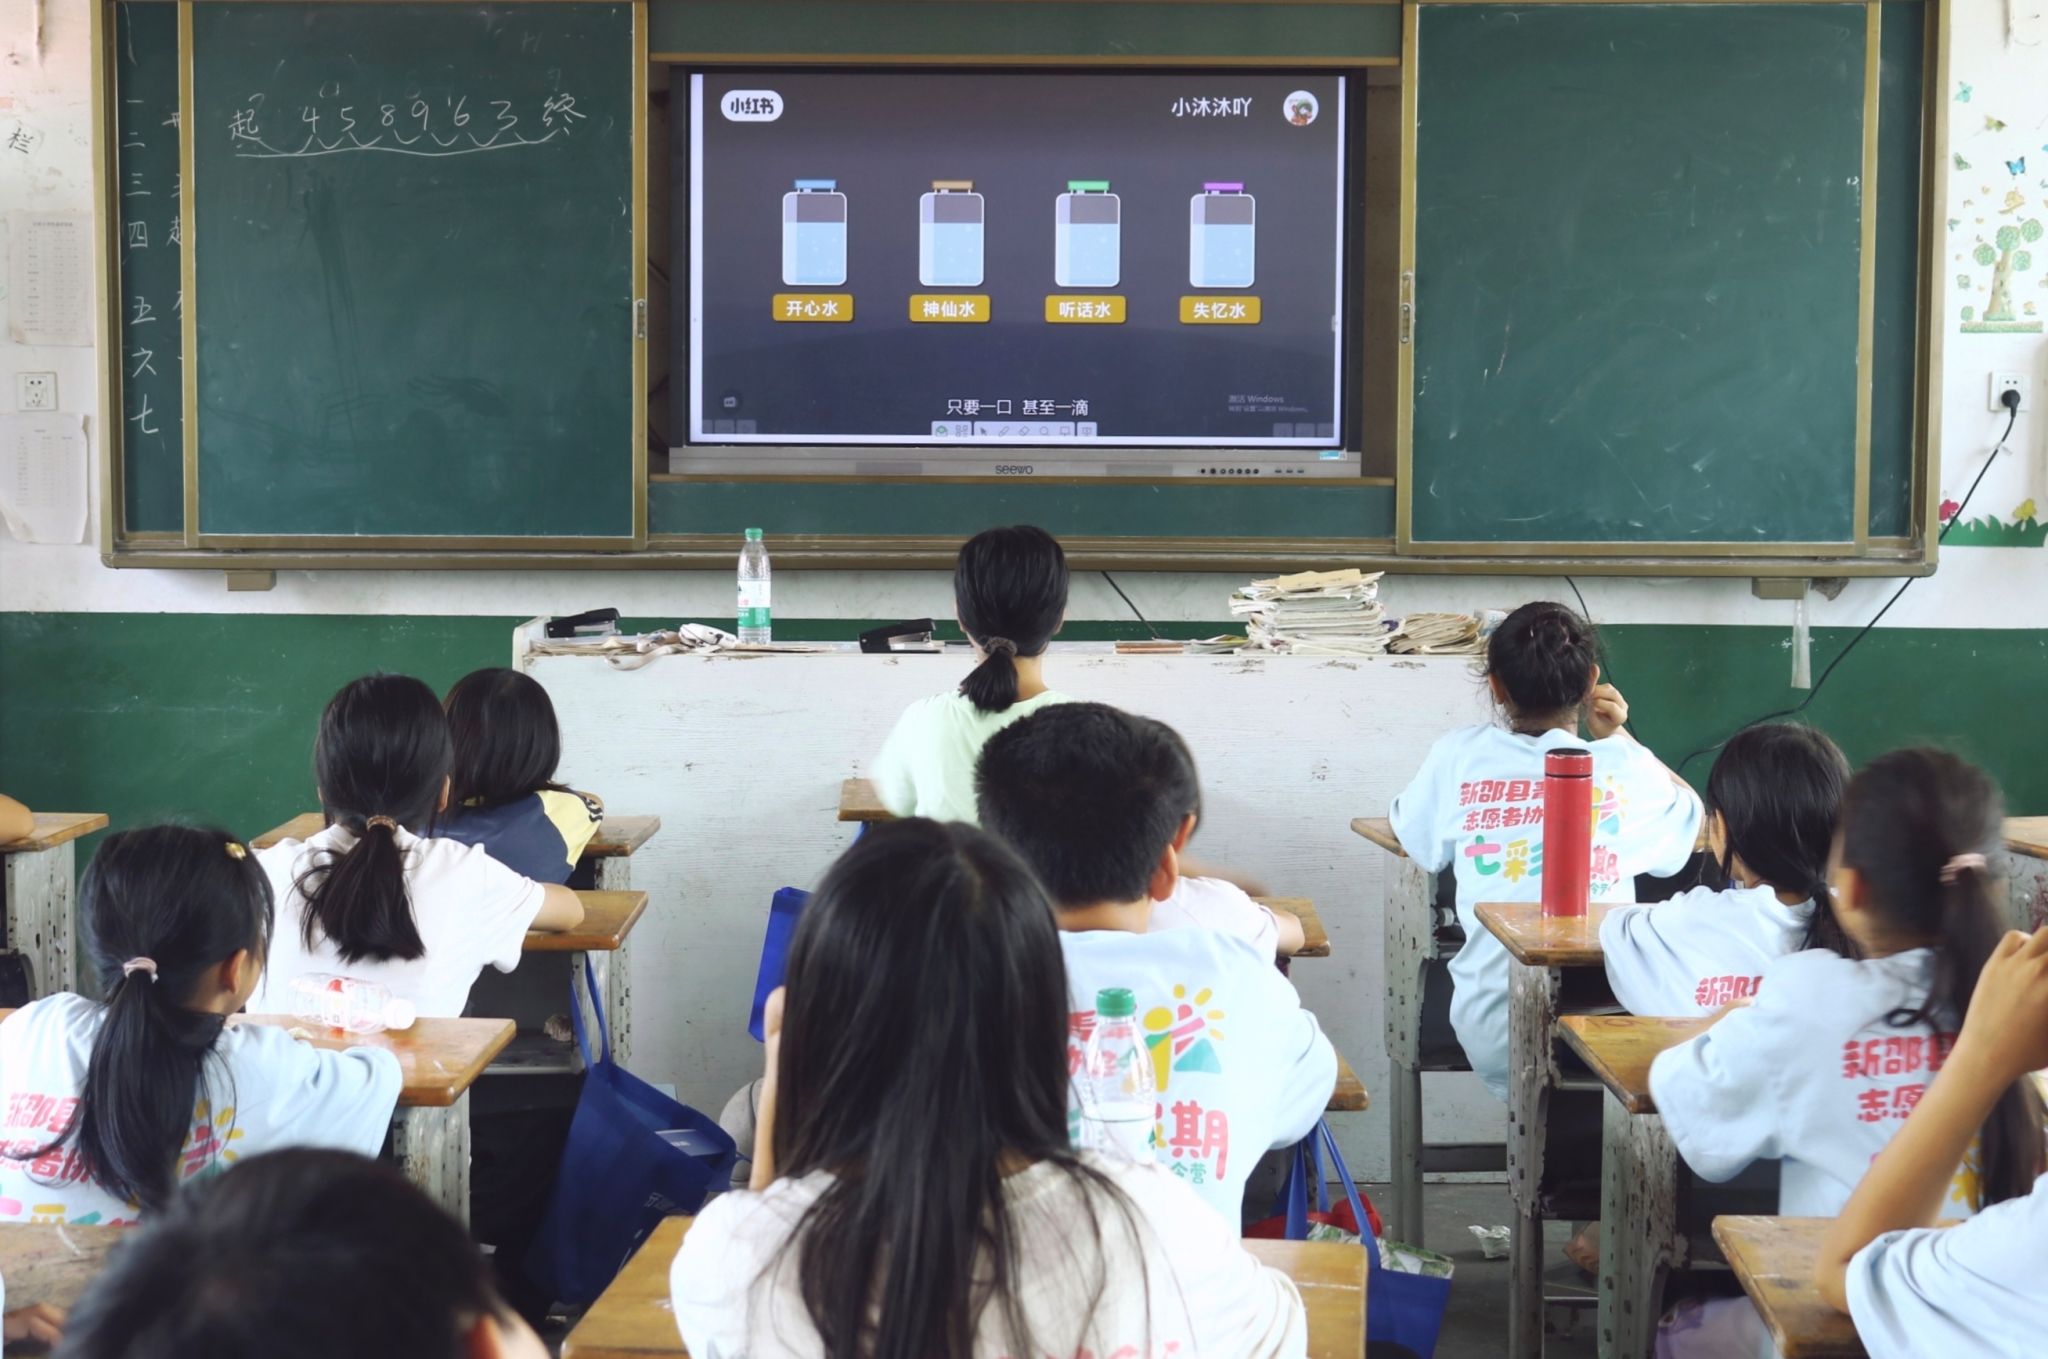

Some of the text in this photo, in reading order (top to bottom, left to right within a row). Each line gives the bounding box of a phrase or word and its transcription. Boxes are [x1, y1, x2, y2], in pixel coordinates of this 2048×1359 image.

[730, 97, 774, 115] 小红书
[1171, 97, 1252, 117] 小沐沐吖
[786, 300, 838, 317] 开心水
[923, 300, 975, 317] 神仙水
[1059, 301, 1111, 318] 听话水
[1193, 302, 1246, 319] 失忆水
[946, 399, 1089, 416] 只要一口 甚至一滴
[995, 464, 1034, 475] seewo
